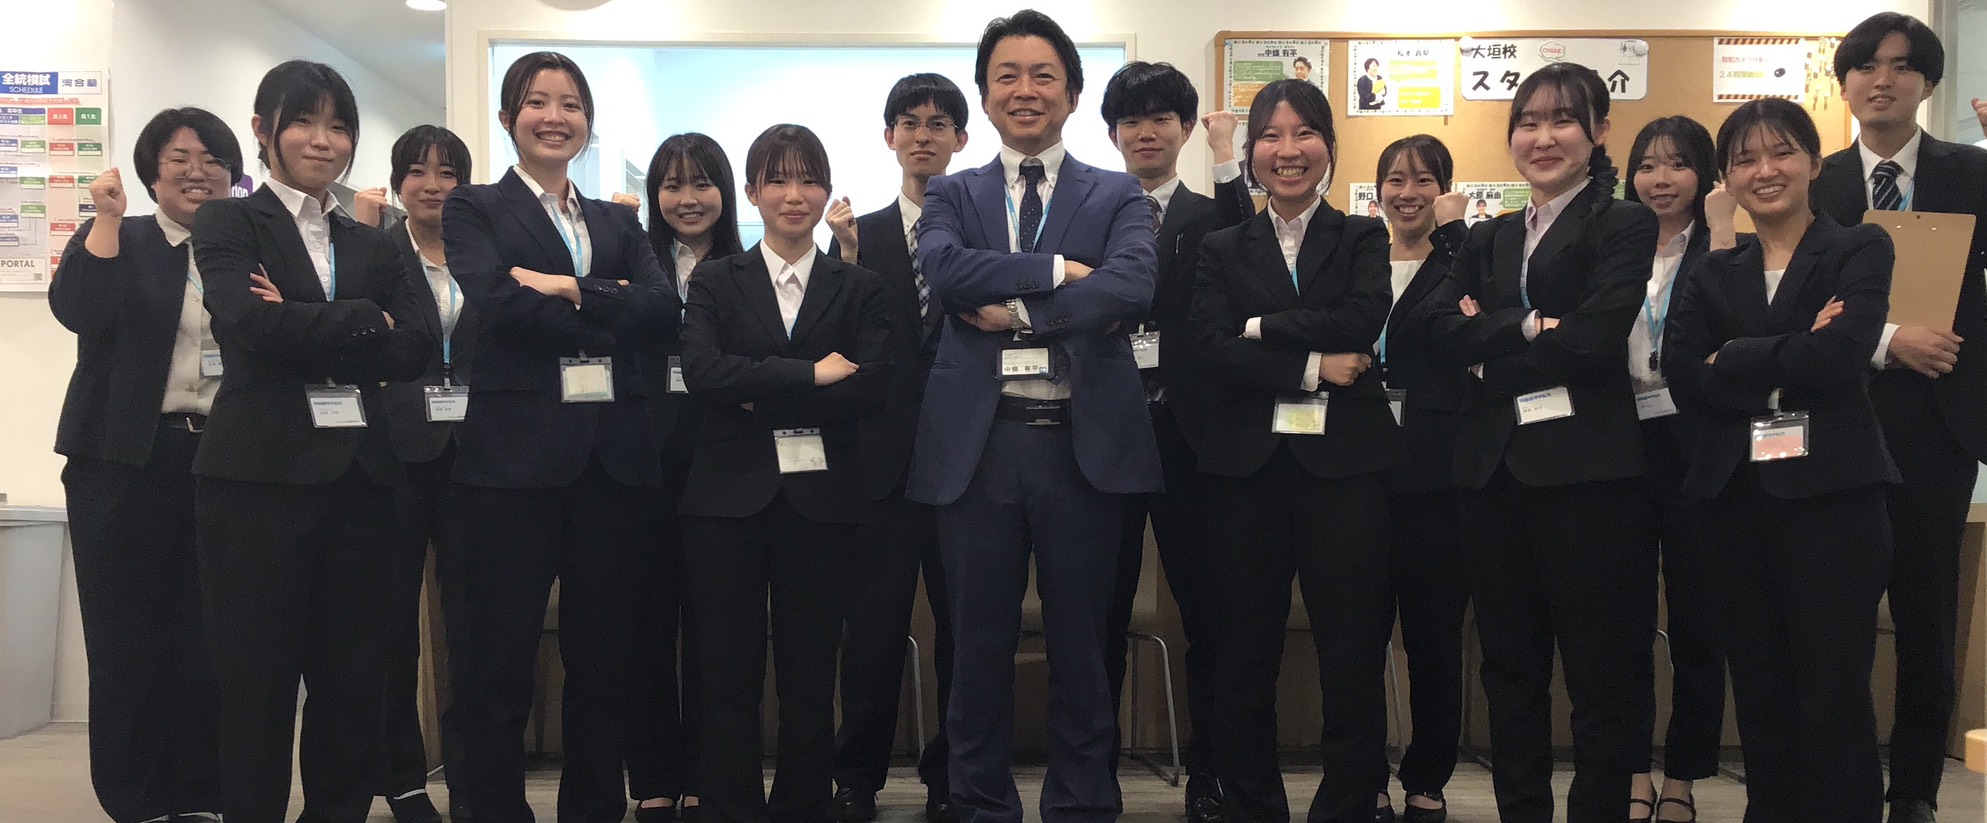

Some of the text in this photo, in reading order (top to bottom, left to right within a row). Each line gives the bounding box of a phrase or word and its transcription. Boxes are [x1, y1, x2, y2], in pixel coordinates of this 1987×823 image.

[1472, 44, 1518, 59] 大垣校
[2, 73, 51, 86] 全統模試
[62, 78, 97, 87] 河合塾
[9, 86, 44, 94] SCHEDULE
[1, 260, 35, 268] PORTAL
